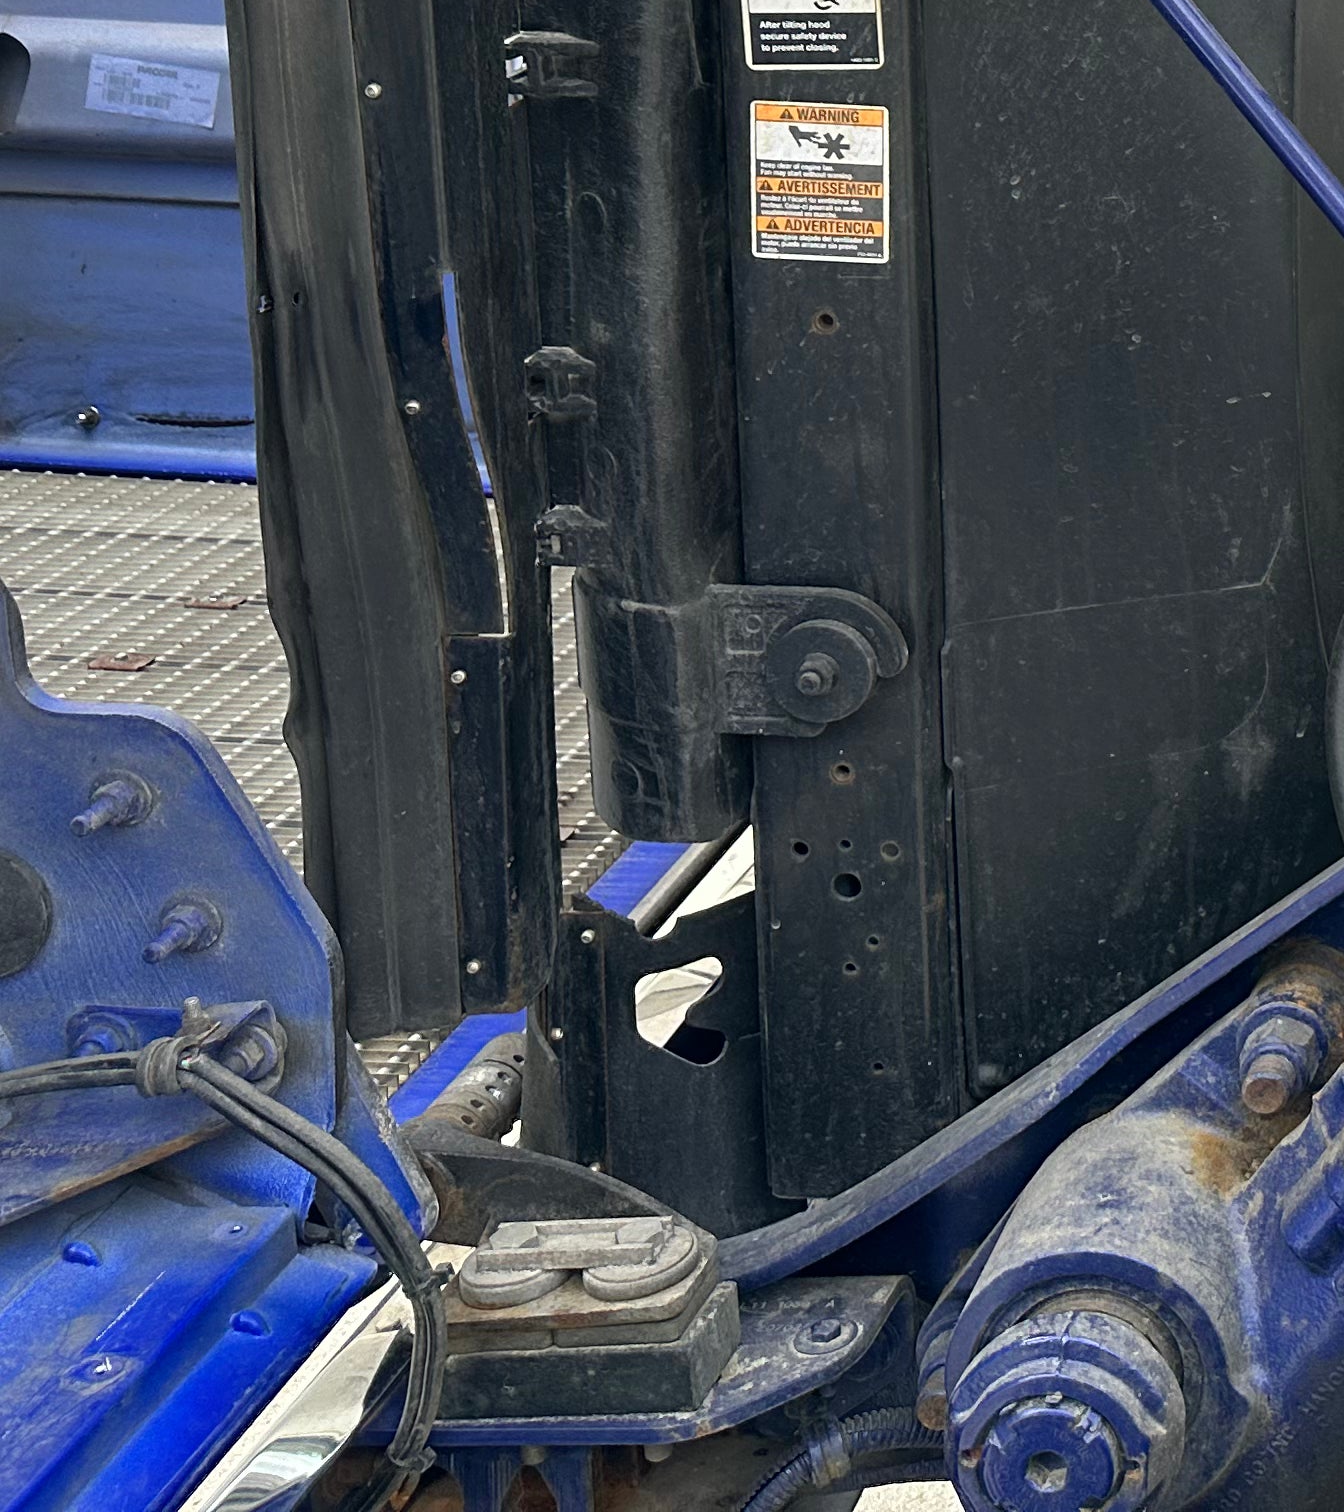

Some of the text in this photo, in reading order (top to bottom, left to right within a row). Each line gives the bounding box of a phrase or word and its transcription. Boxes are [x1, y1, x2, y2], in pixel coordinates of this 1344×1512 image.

[760, 21, 780, 29] After
[782, 21, 807, 30] tilting
[791, 32, 817, 41] safety
[819, 32, 846, 40] device
[761, 44, 770, 52] to
[772, 44, 805, 53] prevent
[797, 108, 859, 123] WARNING
[778, 180, 880, 196] AVERTISSEMENT
[784, 219, 875, 235] ADVERTENCIA
